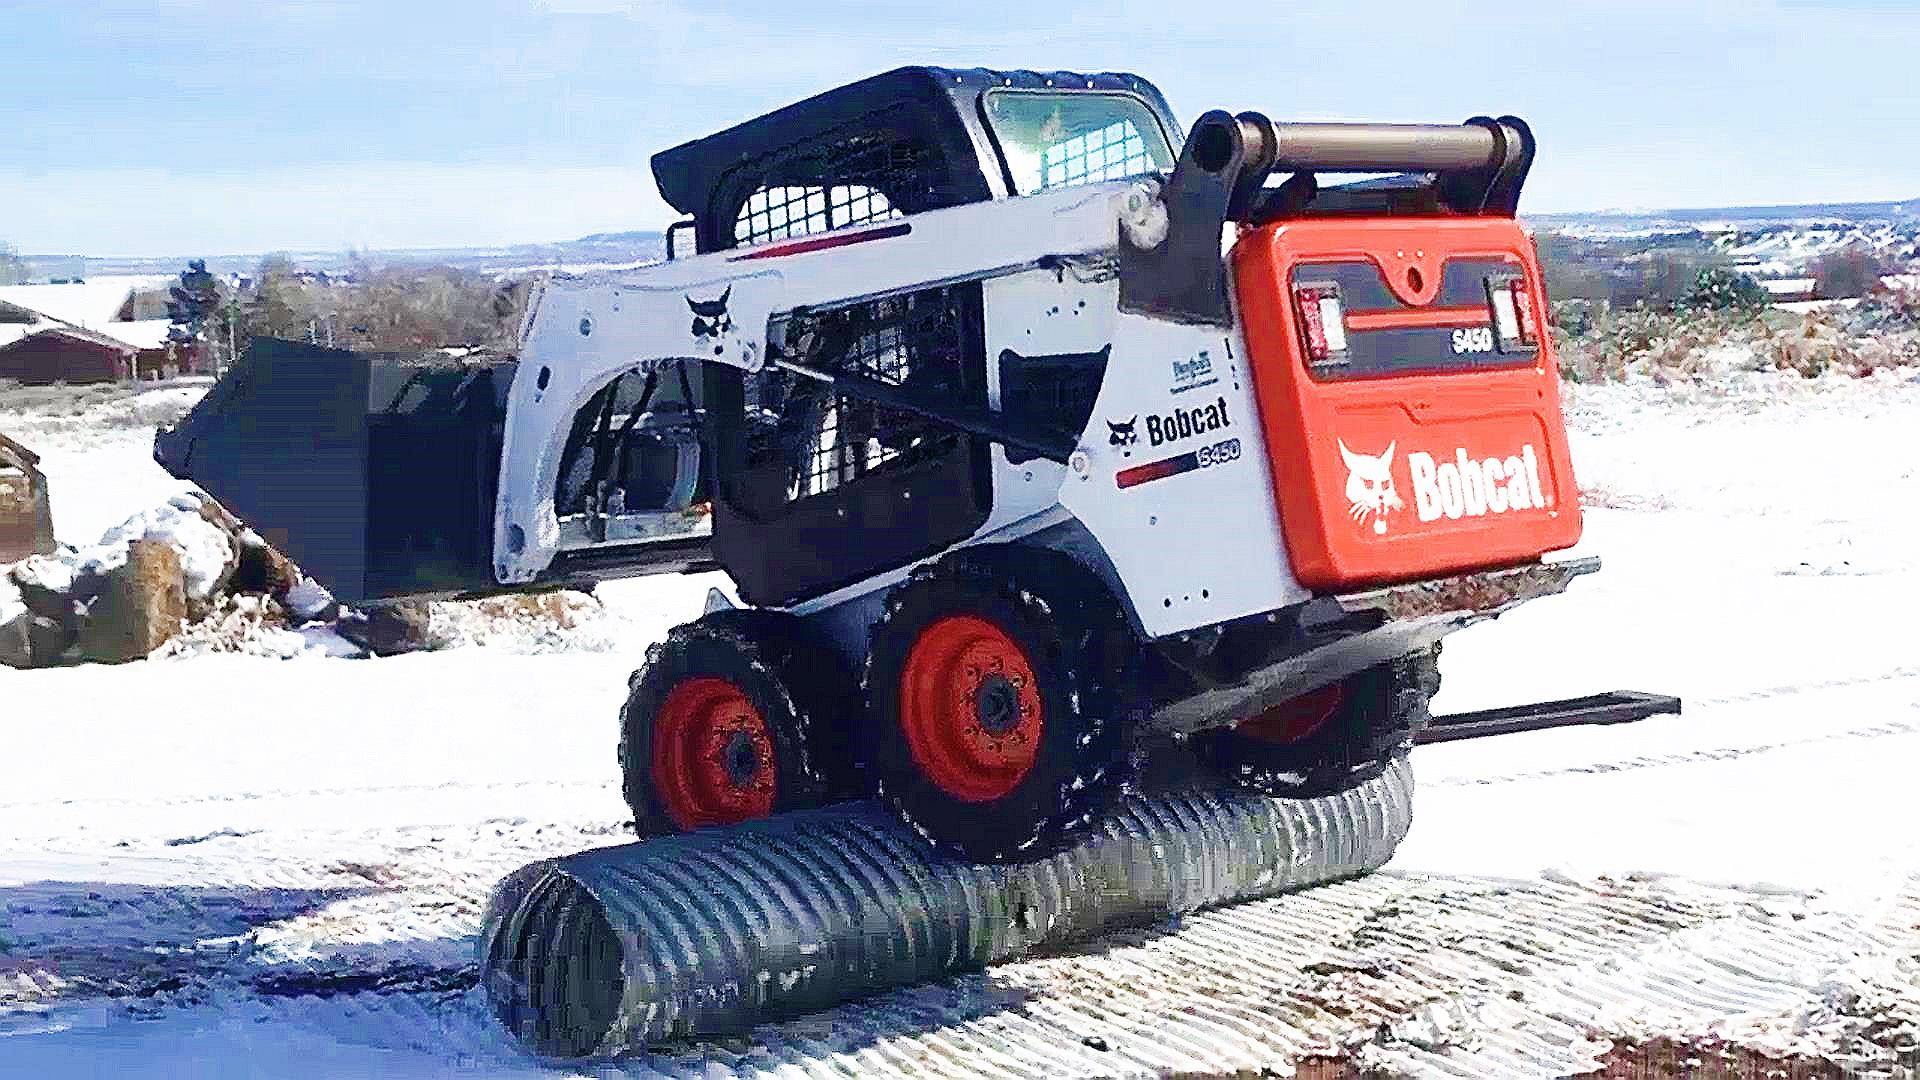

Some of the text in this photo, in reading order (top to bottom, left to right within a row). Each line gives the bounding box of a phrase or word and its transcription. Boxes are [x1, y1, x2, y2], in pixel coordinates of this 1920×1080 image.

[1452, 327, 1491, 353] S450
[1146, 396, 1231, 446] Bobcat
[1408, 444, 1545, 521] Bobcat
